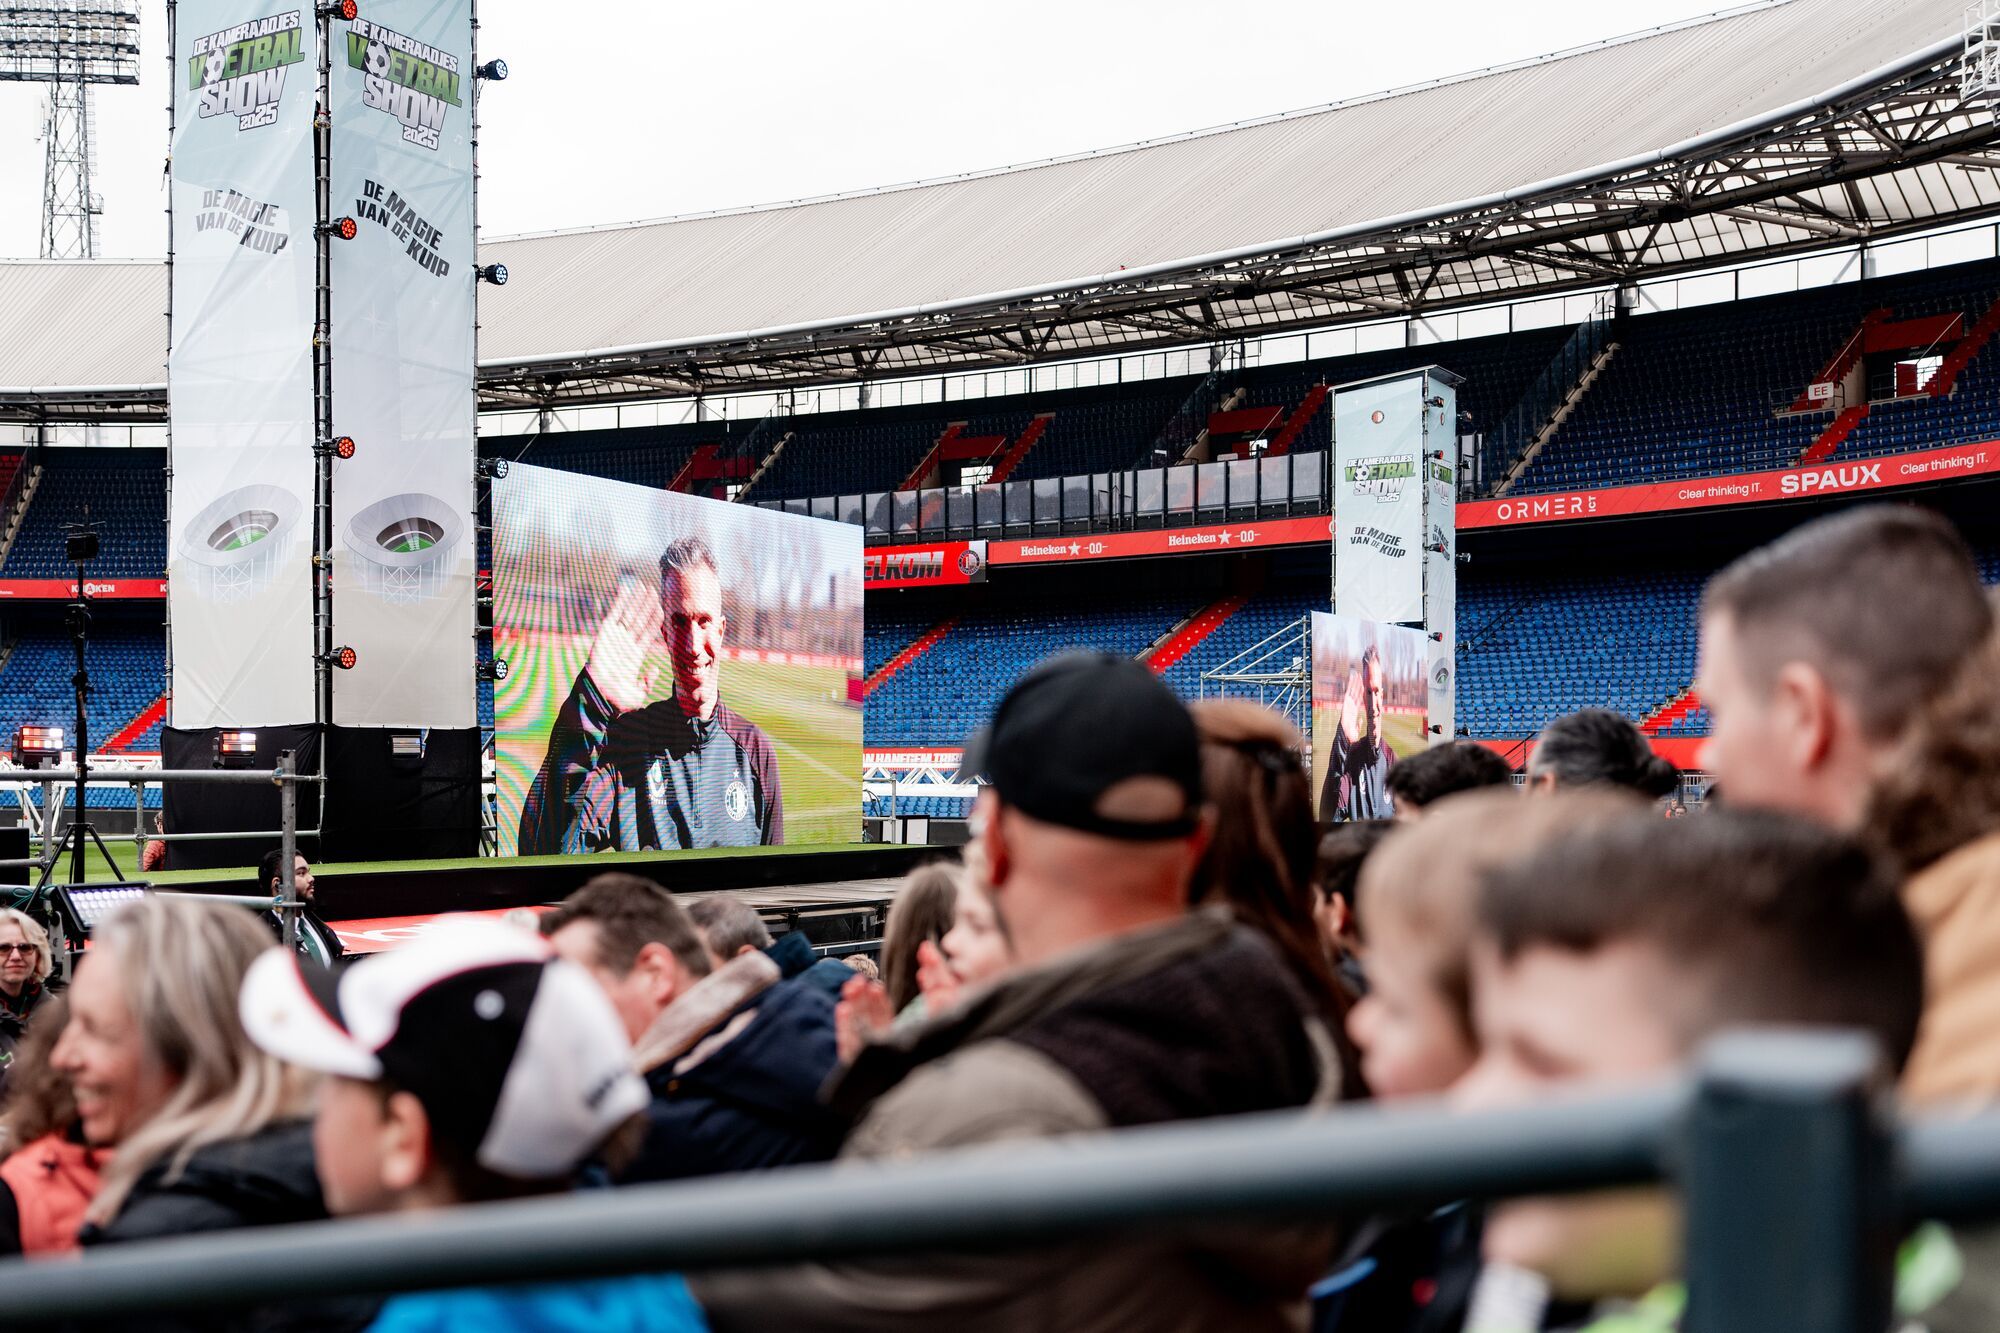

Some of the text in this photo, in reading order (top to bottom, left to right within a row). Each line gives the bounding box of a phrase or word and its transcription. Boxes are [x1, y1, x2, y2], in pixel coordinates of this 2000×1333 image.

[193, 10, 300, 56] DE KAMERAADJES
[351, 18, 458, 72] DE KAMERAADJES
[189, 27, 305, 91] VOETBAL
[346, 31, 462, 108] VOETBAL
[199, 65, 288, 118] SHOW
[363, 73, 448, 132] SHOW
[239, 101, 278, 131] 2025
[402, 124, 439, 151] 2025
[203, 189, 279, 227] DE MAGIE
[363, 179, 443, 251] DE MAGIE
[196, 212, 288, 254] VAN DE KUIP
[355, 199, 450, 278] VAN DE KUIP
[1813, 385, 1828, 397] EE
[1345, 462, 1416, 482] VOETBAL
[1781, 463, 1881, 494] SPAUX
[1900, 452, 1989, 475] Clear thinking IT.
[1353, 478, 1406, 496] SHOW
[1678, 482, 1763, 500] Clear thinking IT.
[1497, 495, 1597, 520] ORMER ICT
[1021, 544, 1067, 557] Heineken
[1168, 533, 1217, 546] Heineken
[1350, 536, 1406, 558] VAN DE KUIP
[1354, 526, 1402, 547] DE MAGIE
[864, 551, 945, 582] ELKOM
